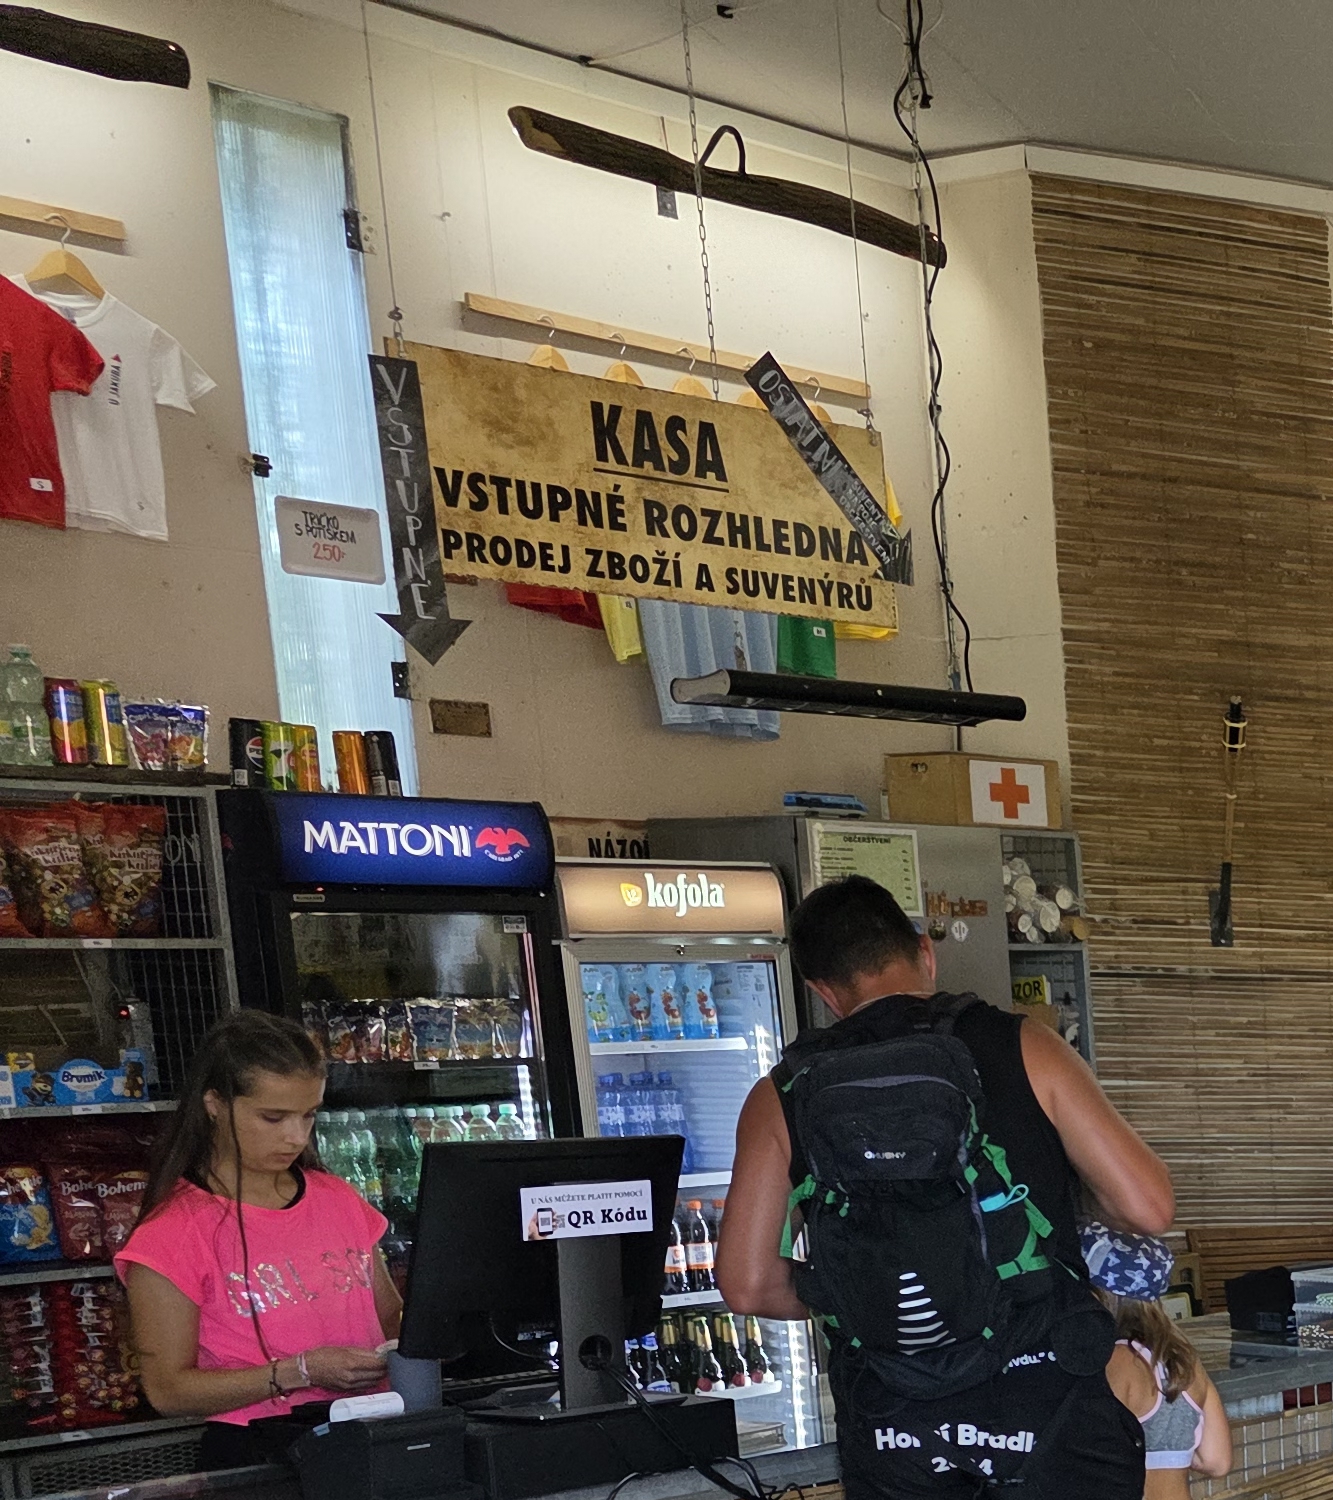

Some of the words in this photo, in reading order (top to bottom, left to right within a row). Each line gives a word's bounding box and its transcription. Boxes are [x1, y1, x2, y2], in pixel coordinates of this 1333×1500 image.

[590, 401, 728, 483] KASA
[294, 524, 302, 537] S
[305, 524, 357, 544] POTISKEM
[302, 511, 339, 528] TRIČKO
[434, 466, 628, 531] VSTUPNÉ
[644, 499, 869, 567] ROZHLEDNA
[442, 527, 572, 575] PRODEJ
[586, 544, 682, 590] ZBOŽÍ
[695, 563, 715, 592] A
[726, 569, 874, 613] SUVENÝRŮ
[303, 819, 471, 858] MATTONI
[643, 871, 725, 917] kofola
[538, 1195, 553, 1204] NÁS
[555, 1193, 586, 1203] MŮŽETE
[588, 1191, 613, 1201] PLATIT
[614, 1188, 643, 1198] POMOCÍ
[568, 1210, 596, 1229] QR
[601, 1206, 648, 1224] Kódu
[957, 1423, 1037, 1454] Bradl
